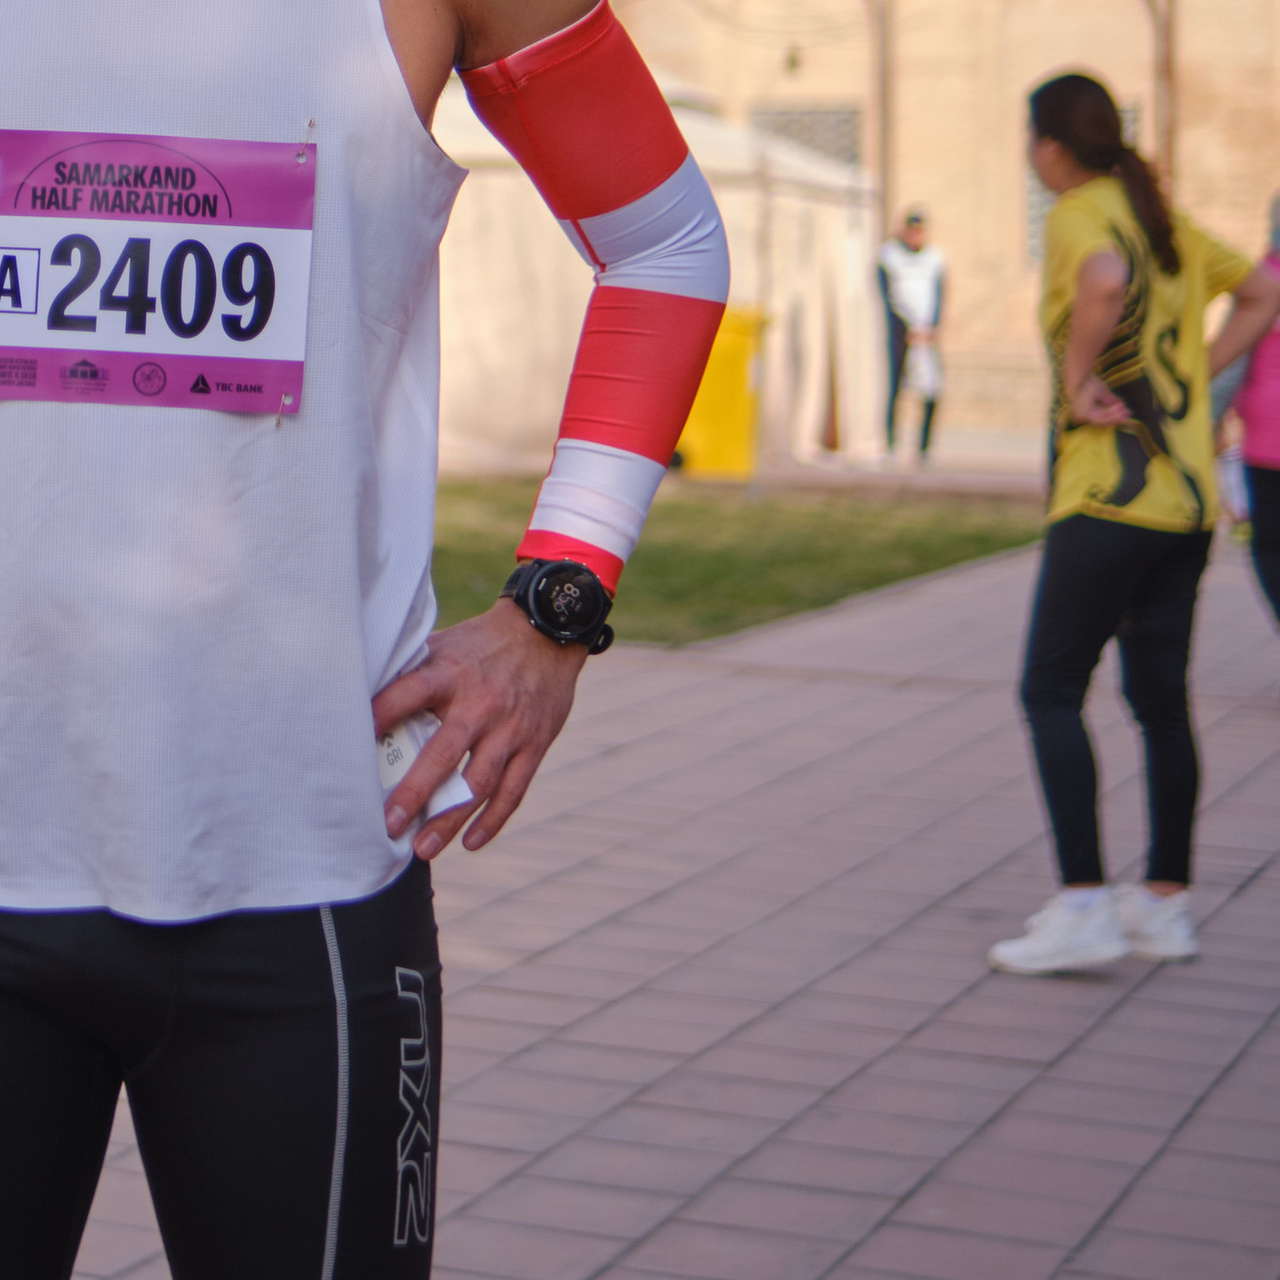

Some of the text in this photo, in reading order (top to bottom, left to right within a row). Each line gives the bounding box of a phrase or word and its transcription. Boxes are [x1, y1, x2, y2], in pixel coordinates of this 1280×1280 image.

[55, 161, 196, 190] SAMARKAND
[31, 186, 218, 218] HALF MARATHON
[46, 233, 276, 342] 2409
[215, 382, 263, 394] TBC BANK
[393, 966, 432, 1245] 2XU
